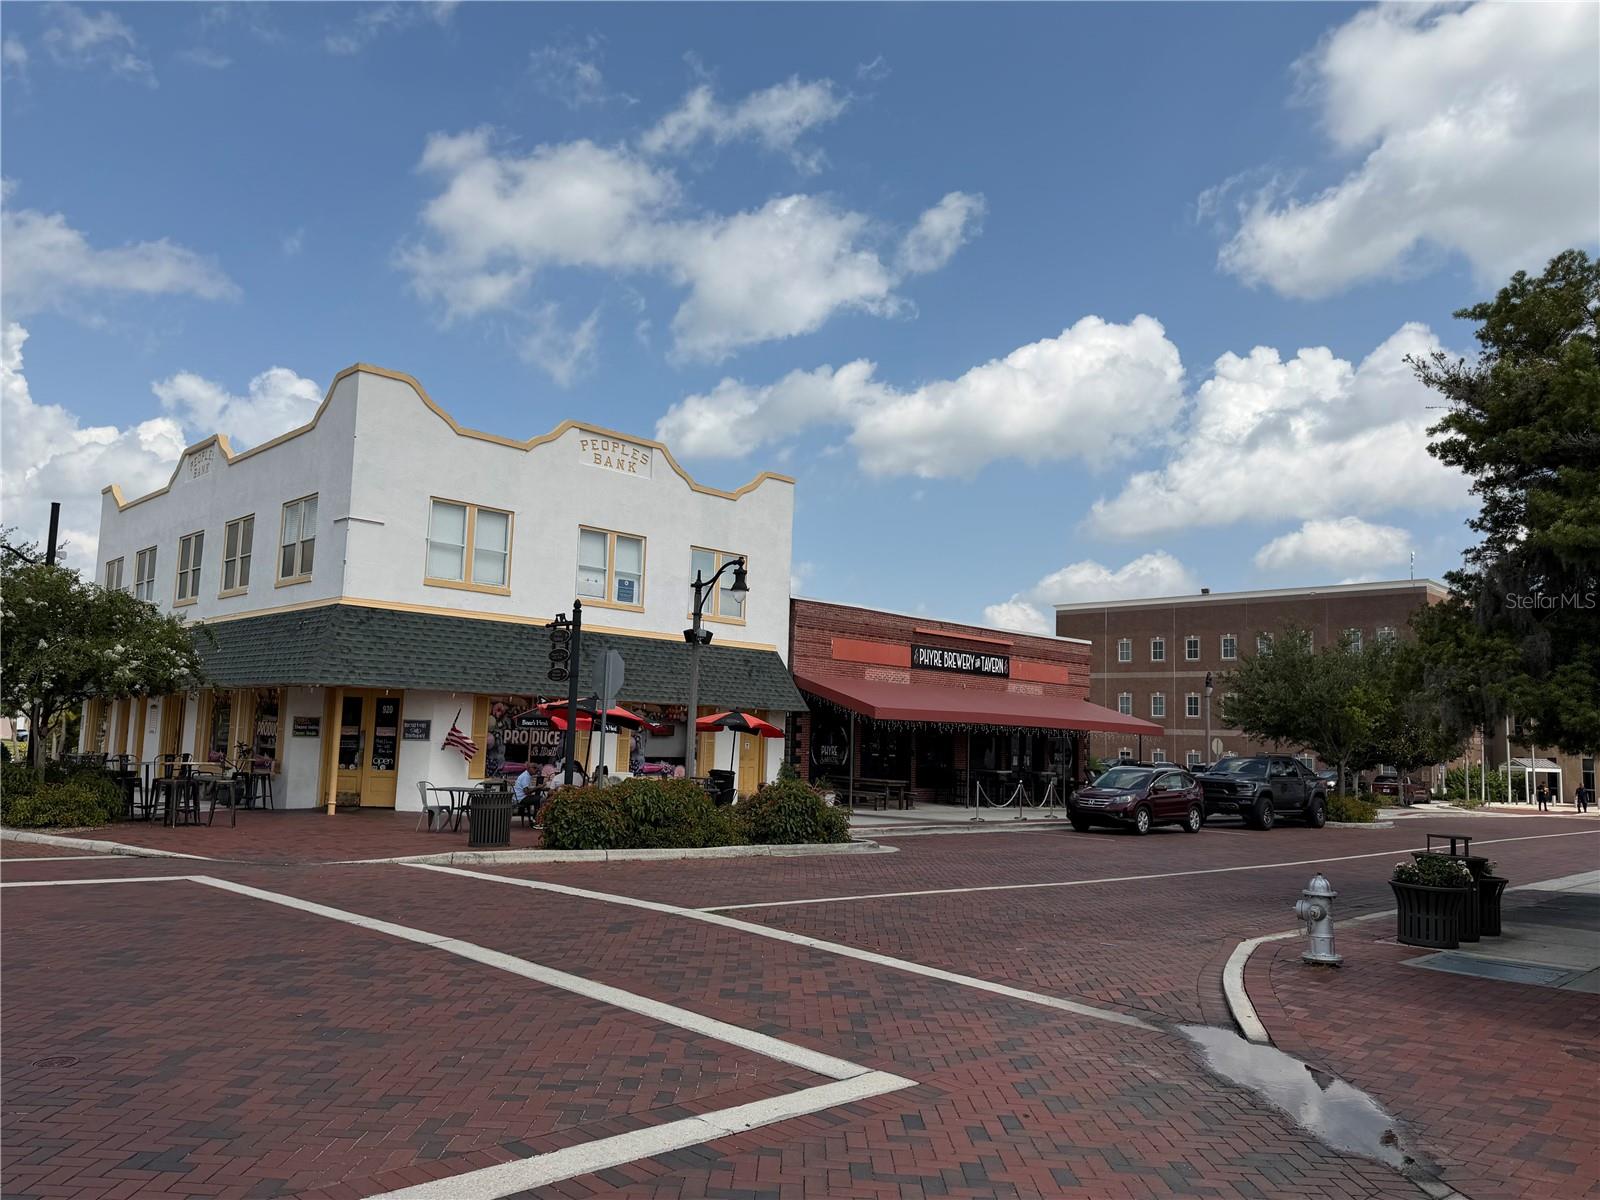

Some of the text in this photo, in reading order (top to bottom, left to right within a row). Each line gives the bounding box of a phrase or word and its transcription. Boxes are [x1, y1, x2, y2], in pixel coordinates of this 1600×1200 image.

[580, 439, 649, 465] PEOPLES
[593, 452, 636, 473] BANK
[919, 648, 943, 667] PHYRE
[943, 651, 975, 671] BREWERY
[981, 656, 1004, 674] TAVERN
[503, 729, 560, 745] PRODUCE
